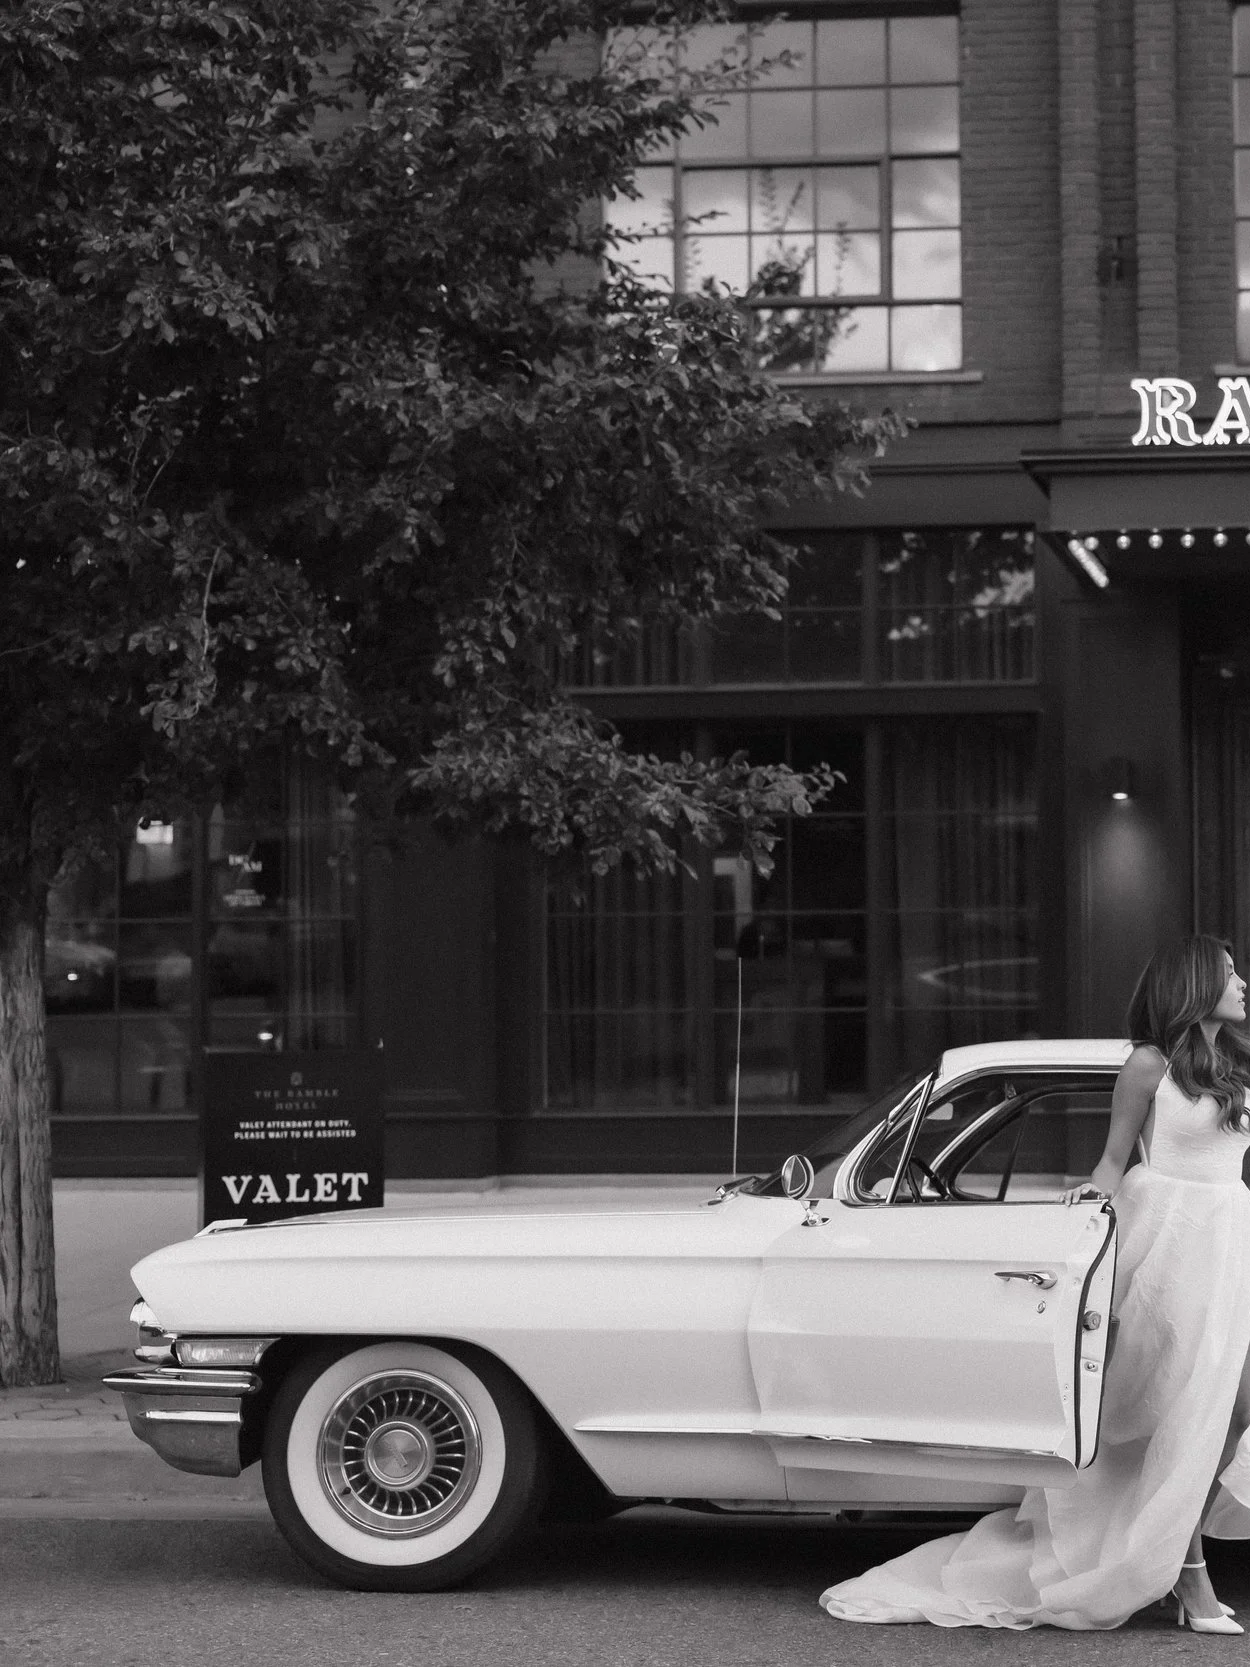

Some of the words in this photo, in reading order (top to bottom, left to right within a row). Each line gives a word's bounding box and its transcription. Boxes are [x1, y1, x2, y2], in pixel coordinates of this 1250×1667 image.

[239, 1121, 265, 1129] VALET
[266, 1120, 313, 1129] ATTENDANT
[314, 1120, 326, 1128] ON
[234, 1131, 266, 1140] PLEASE
[268, 1130, 288, 1139] WAIT
[290, 1130, 301, 1139] TO
[303, 1130, 314, 1138] BE
[316, 1129, 357, 1138] ASSISTED
[221, 1172, 369, 1204] VALET
